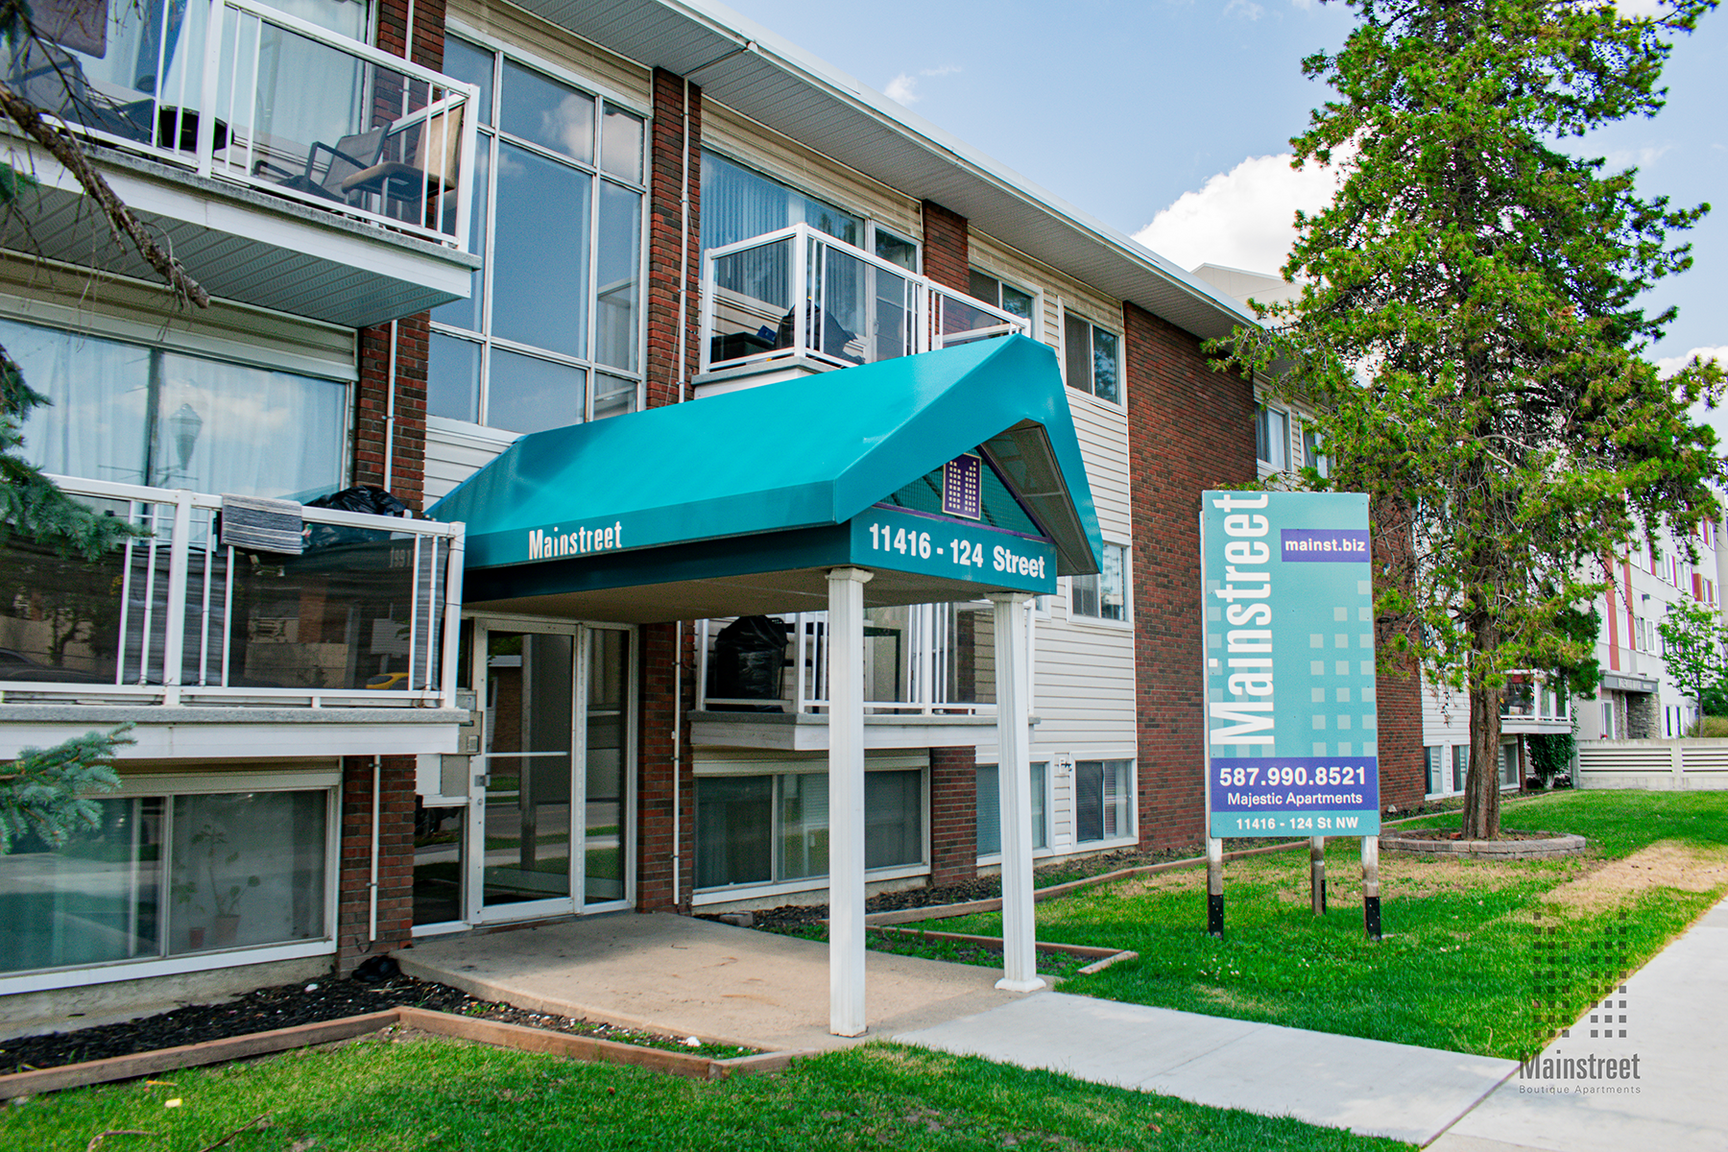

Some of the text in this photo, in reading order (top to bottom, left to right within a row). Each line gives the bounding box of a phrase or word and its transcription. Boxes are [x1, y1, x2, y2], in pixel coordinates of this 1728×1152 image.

[528, 520, 622, 560] Mainstreet
[1285, 537, 1366, 552] mainst.biz
[869, 523, 1045, 579] 11416 - 124 Street
[1208, 493, 1275, 745] Mainstreet
[1219, 766, 1365, 786] 587.990.8521
[1227, 792, 1363, 807] Majestic Apartments
[1236, 817, 1276, 830] 11416
[1289, 817, 1313, 830] 124
[1317, 816, 1332, 829] St
[1336, 816, 1359, 829] NW
